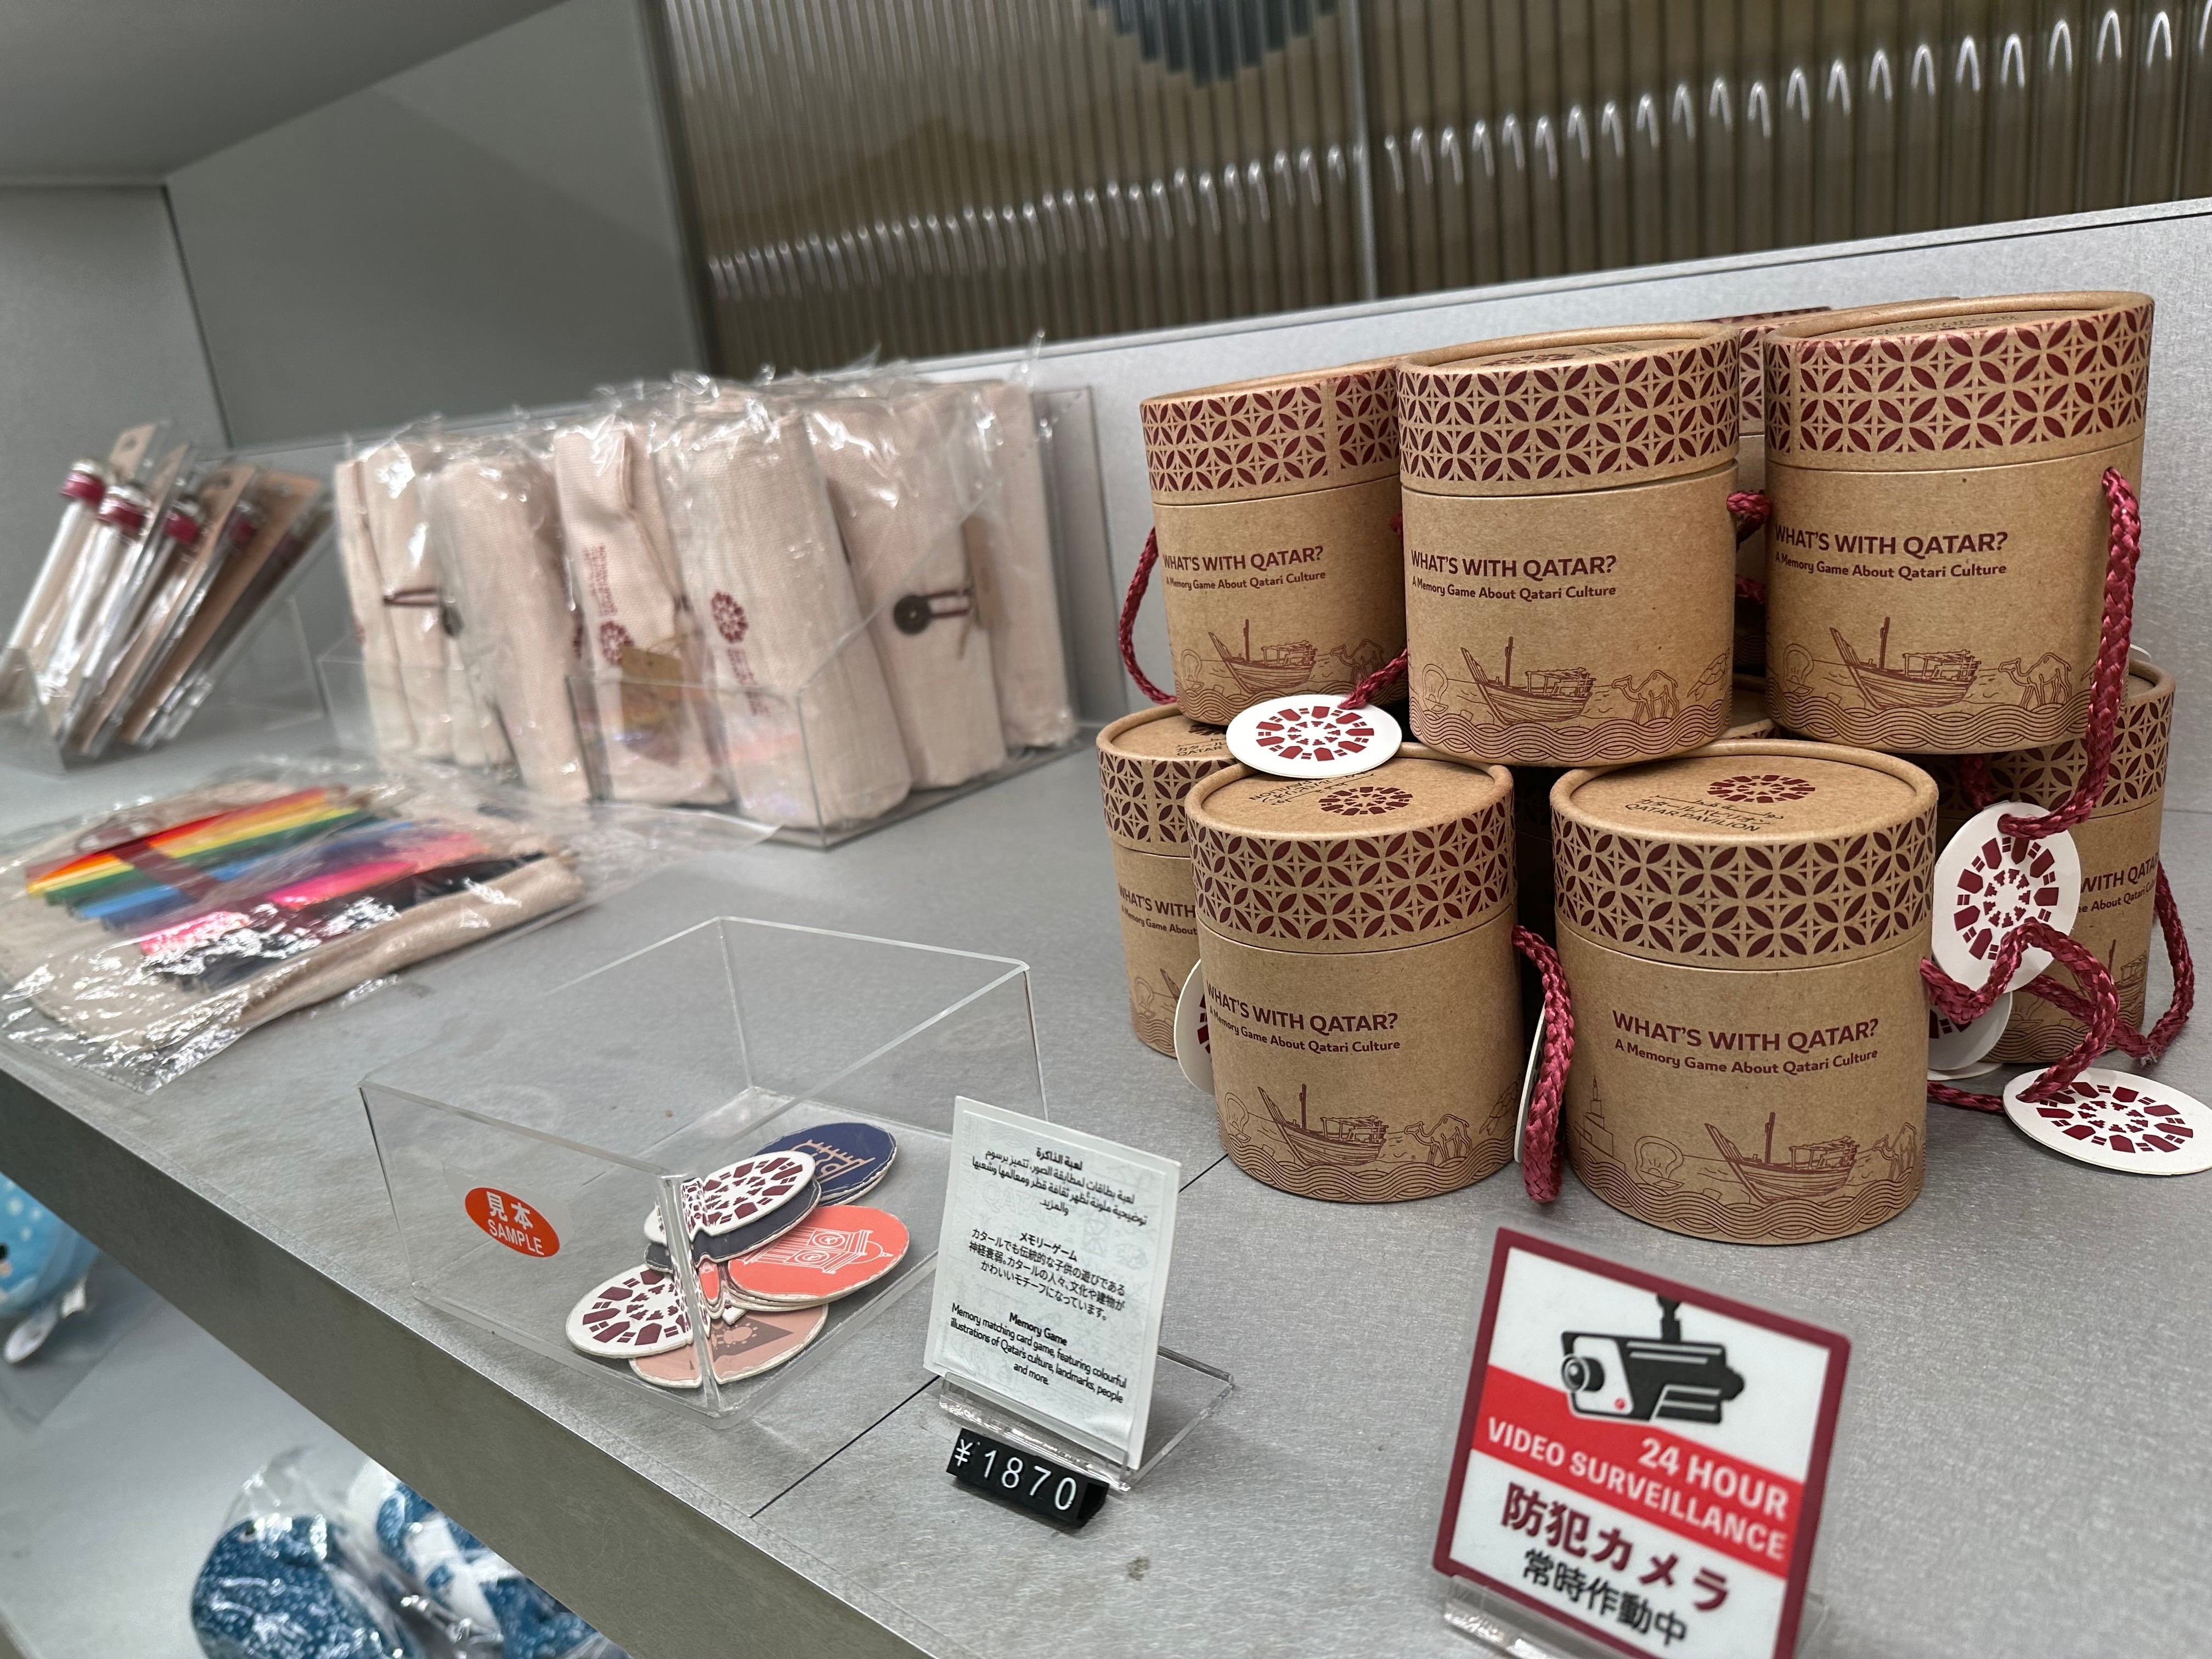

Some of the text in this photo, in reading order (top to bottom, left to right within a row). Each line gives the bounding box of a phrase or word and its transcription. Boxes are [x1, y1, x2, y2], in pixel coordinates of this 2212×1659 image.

[1163, 545, 1324, 572] WHAT'S WITH QATAR?
[1775, 523, 2008, 560] WHAT'S WITH QATAR?
[1193, 579, 1216, 589] Game
[1218, 579, 1247, 589] About
[1250, 575, 1283, 589] Qatari
[1286, 571, 1326, 584] Culture
[1410, 549, 1617, 582] WHAT'S WITH QATAR?
[1775, 552, 2007, 581] A Memory Game About Qatari Culture
[1412, 575, 1616, 602] A Memory Game About Qatari Culture
[1176, 746, 1224, 756] QATAR
[1624, 804, 1761, 832] QATAR PAVILION
[1637, 798, 1771, 825] カタールパビリオン
[1119, 883, 1197, 918] WHAT'S WITH
[2090, 897, 2121, 912] About
[1146, 918, 1167, 932] Game
[1169, 923, 1198, 936] About
[1207, 983, 1398, 1036] WHAT'S WITH QATAR?
[1210, 1005, 1401, 1054] A Memory Game About Qatari Culture
[1612, 1010, 1879, 1054] WHAT'S WITH QATAR?
[1615, 1039, 1878, 1076] A Memory Game About Qatari Culture
[1031, 1178, 1047, 1190] قطر
[486, 1190, 534, 1230] 見本
[487, 1218, 545, 1256] SAMPLE
[1020, 1232, 1077, 1262] メモリーゲーム
[972, 1229, 1125, 1296] カタールでも伝統的な子供の遊びである
[980, 1261, 1107, 1321] かわいいモチーフになっています。
[951, 1303, 1127, 1389] Memory matching card game, featuring colourful
[1009, 1312, 1068, 1346] Memory Game
[950, 1317, 990, 1344] illustrations
[991, 1336, 1001, 1347] of
[1027, 1353, 1054, 1374] culture,
[1055, 1362, 1096, 1392] landmarks,
[1096, 1384, 1124, 1404] people
[1013, 1362, 1049, 1386] and more.
[1488, 1416, 1787, 1562] VIDEO SURVEILLANCE
[1638, 1437, 1790, 1521] 24 HOUR
[1500, 1481, 1730, 1612] 防犯カメラ
[1523, 1548, 1688, 1646] 常時作動中
